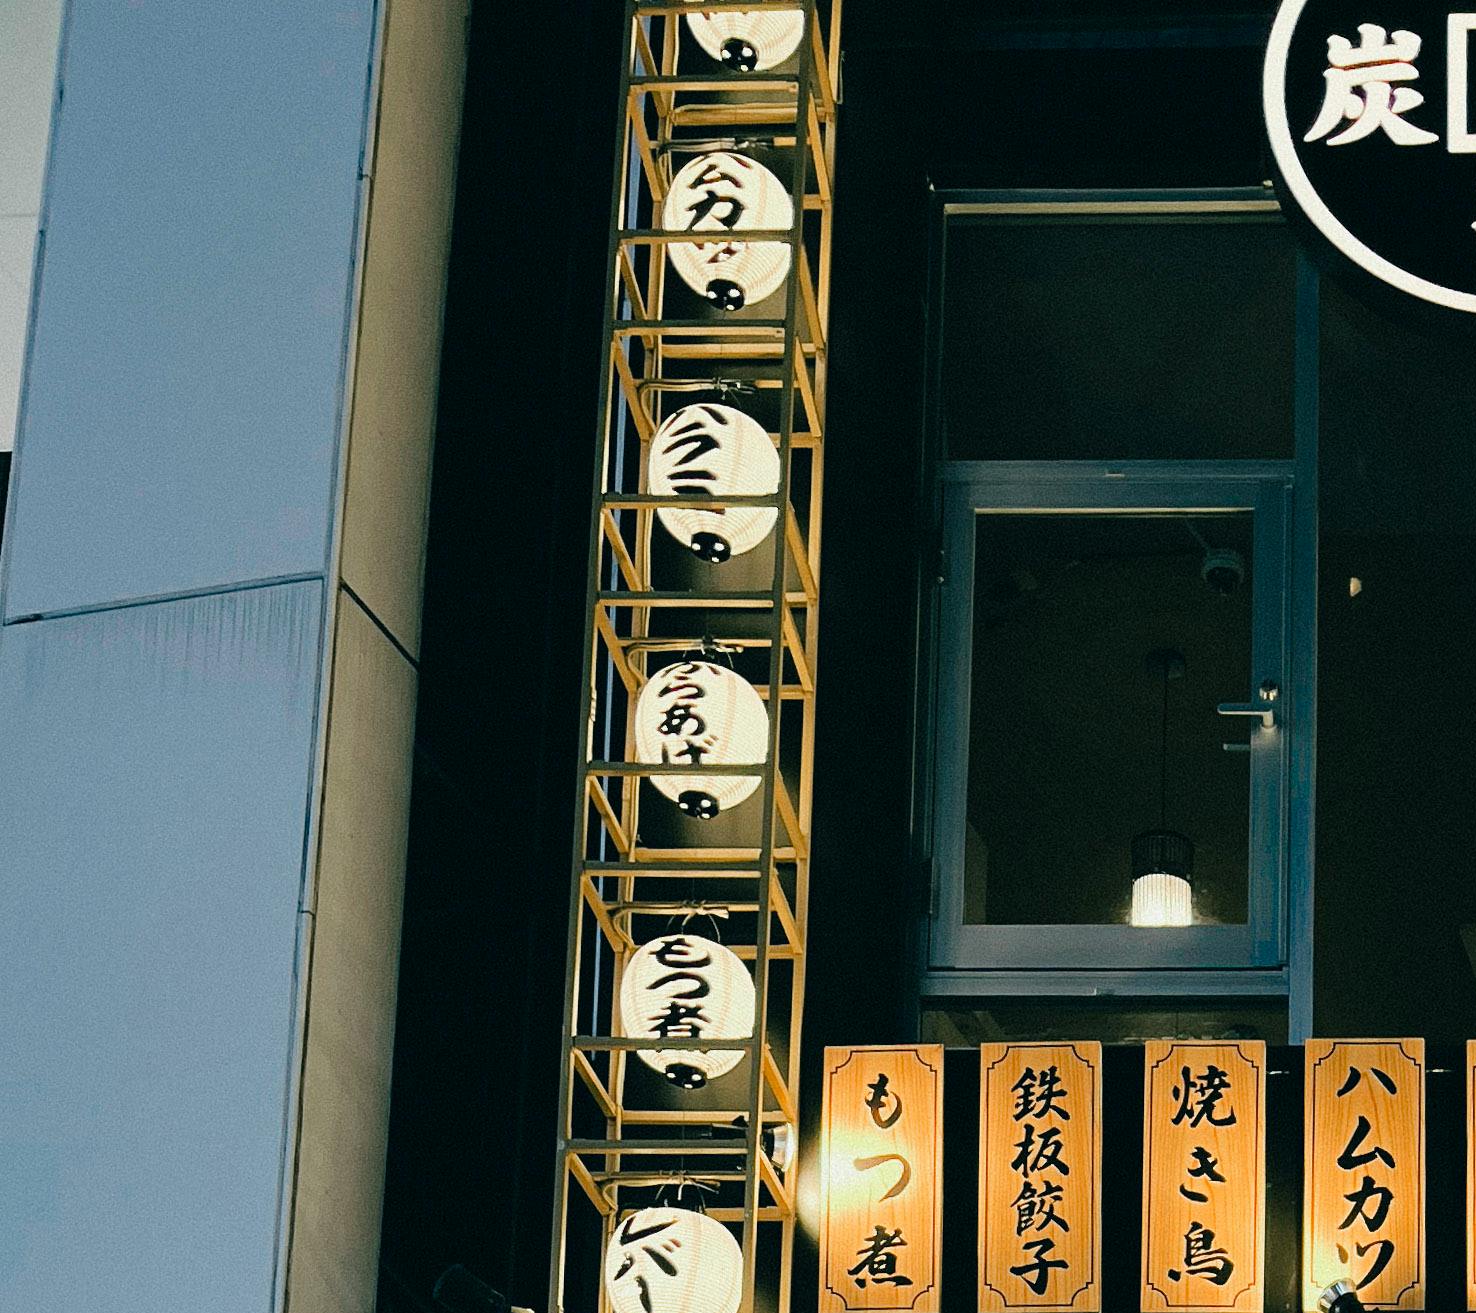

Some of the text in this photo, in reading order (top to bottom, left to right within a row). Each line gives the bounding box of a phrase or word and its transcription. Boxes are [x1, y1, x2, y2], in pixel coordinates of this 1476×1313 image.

[847, 1073, 914, 1290] もつ煮
[1010, 1066, 1071, 1296] 鉄板餃子
[1167, 1065, 1238, 1286] 焼き鳥
[1336, 1066, 1398, 1292] ハムカツ
